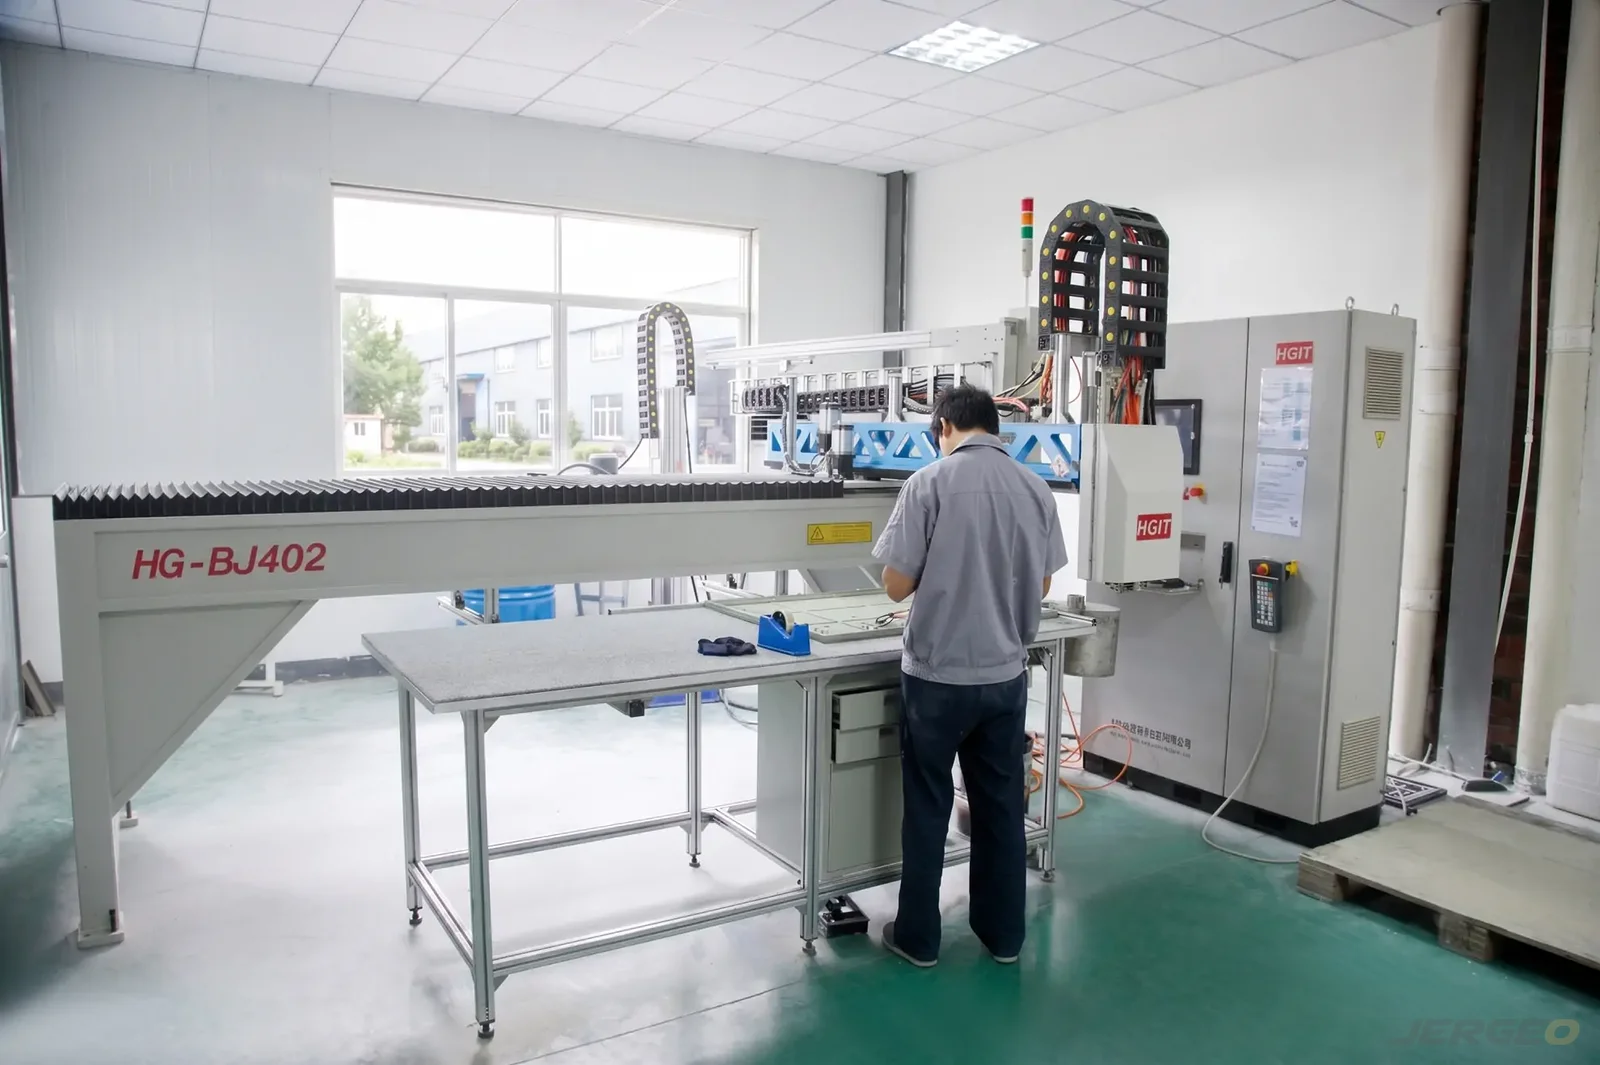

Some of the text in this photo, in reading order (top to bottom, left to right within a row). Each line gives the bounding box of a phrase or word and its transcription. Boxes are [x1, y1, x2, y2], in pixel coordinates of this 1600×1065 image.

[1276, 346, 1312, 361] HGIT
[1137, 519, 1172, 536] HGIT
[132, 543, 327, 579] HG-BJ402
